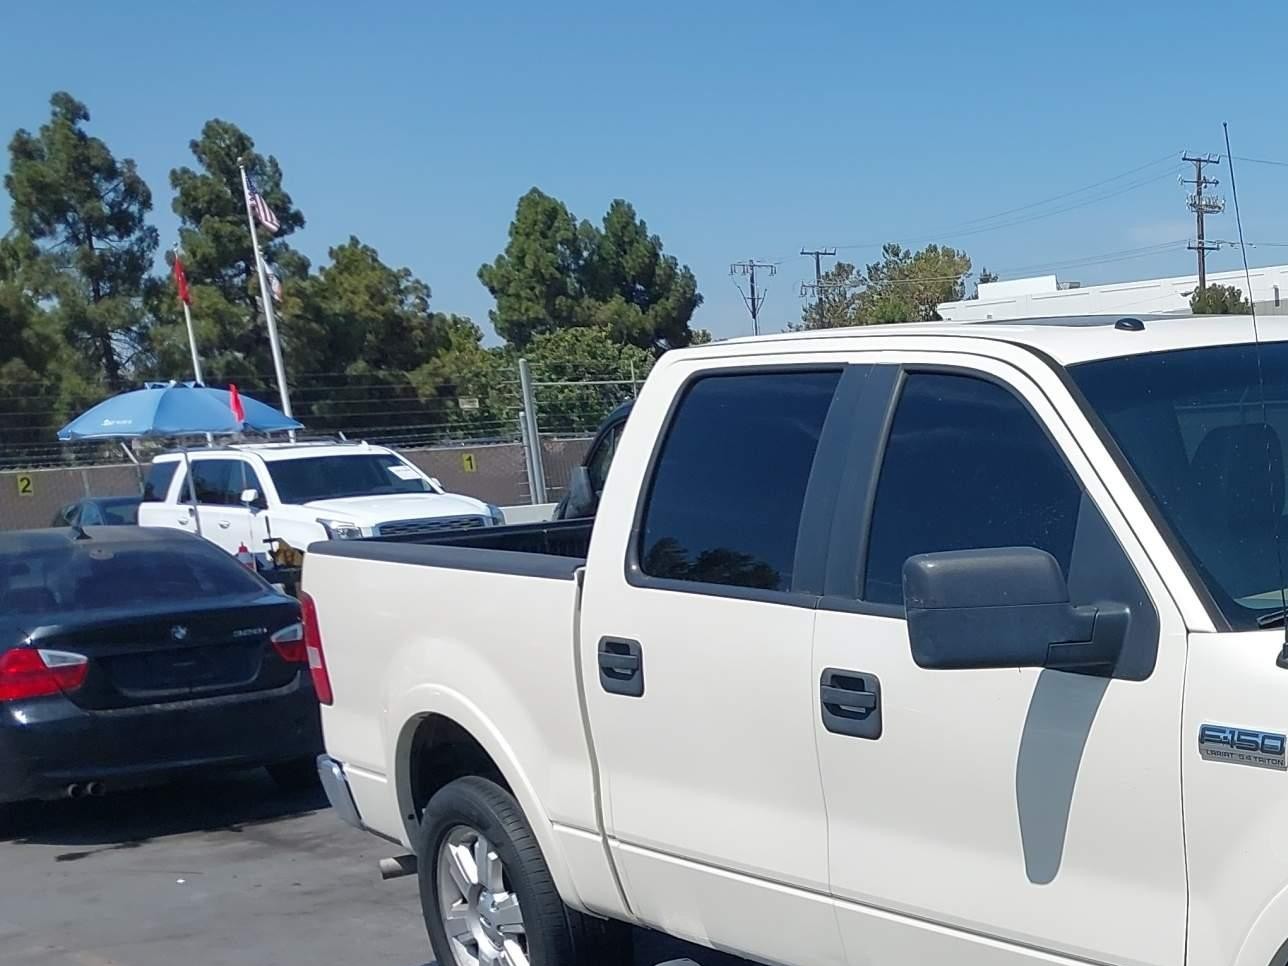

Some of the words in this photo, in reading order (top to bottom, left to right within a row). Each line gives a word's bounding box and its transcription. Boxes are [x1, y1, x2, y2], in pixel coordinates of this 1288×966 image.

[465, 455, 473, 470] 1
[19, 476, 33, 494] 2
[1252, 755, 1285, 767] TRITON
